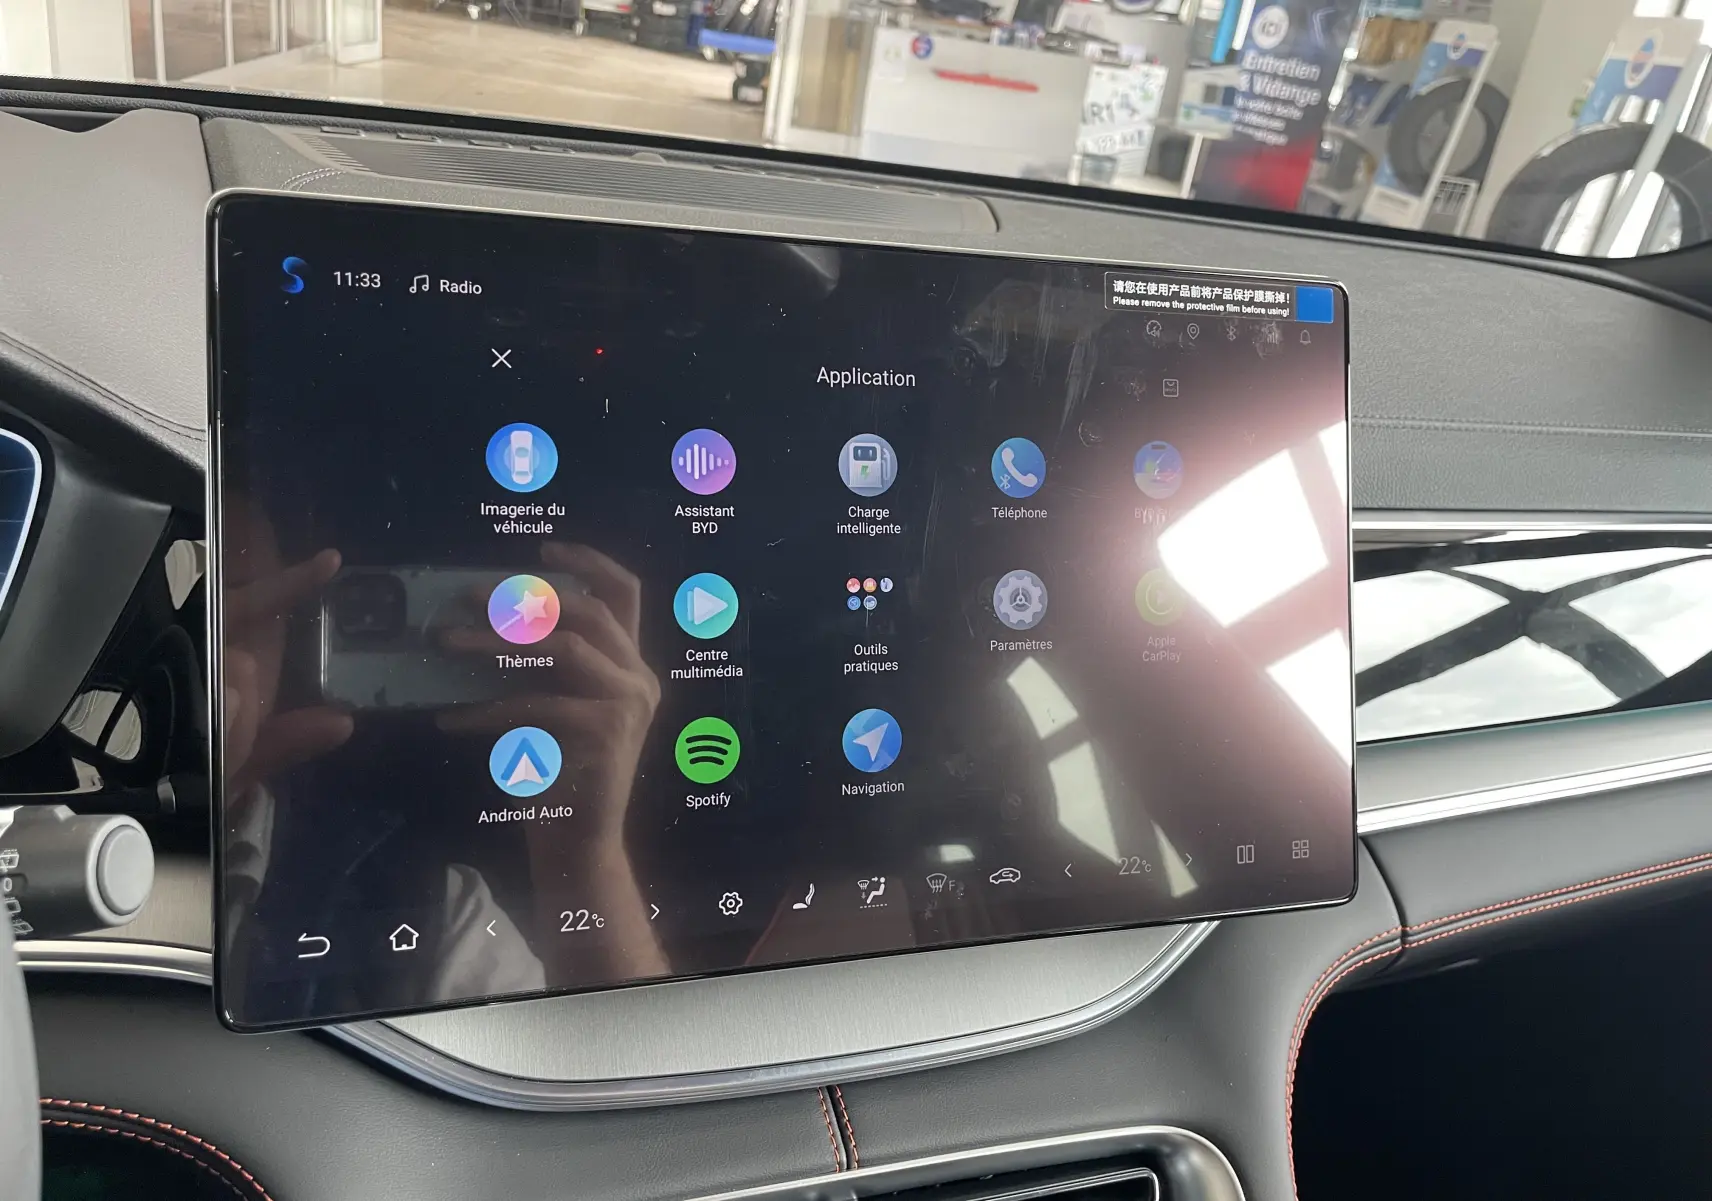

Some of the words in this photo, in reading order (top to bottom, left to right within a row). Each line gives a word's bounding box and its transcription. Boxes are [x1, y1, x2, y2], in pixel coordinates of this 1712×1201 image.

[1242, 50, 1321, 81] Entretien
[1253, 73, 1322, 108] Vidange
[333, 271, 381, 288] 11:33
[439, 279, 483, 295] Radio
[1112, 296, 1140, 306] Please
[1141, 299, 1170, 308] remove
[1172, 300, 1185, 309] the
[1186, 302, 1225, 312] protective
[1226, 304, 1241, 313] film
[1242, 305, 1266, 315] before
[1267, 307, 1290, 318] using!
[816, 366, 916, 388] Application
[480, 502, 544, 519] Imagerie
[547, 502, 565, 516] du
[674, 504, 735, 517] Assistant
[848, 505, 890, 520] Charge
[991, 506, 1048, 521] Téléphone
[493, 519, 553, 534] véhicule
[692, 521, 718, 534] BYD
[837, 522, 901, 537] intelligente
[854, 642, 888, 656] Outils
[990, 638, 1053, 652] Paramètres
[1147, 635, 1177, 649] Apple
[495, 653, 554, 669] Thèmes
[685, 649, 729, 662] Centre
[1142, 649, 1182, 663] CarPlay
[670, 665, 743, 680] multimédia
[844, 660, 899, 675] pratiques
[841, 781, 905, 797] Navigation
[686, 792, 731, 809] Spotify
[478, 806, 535, 824] Android
[539, 805, 573, 819] Auto
